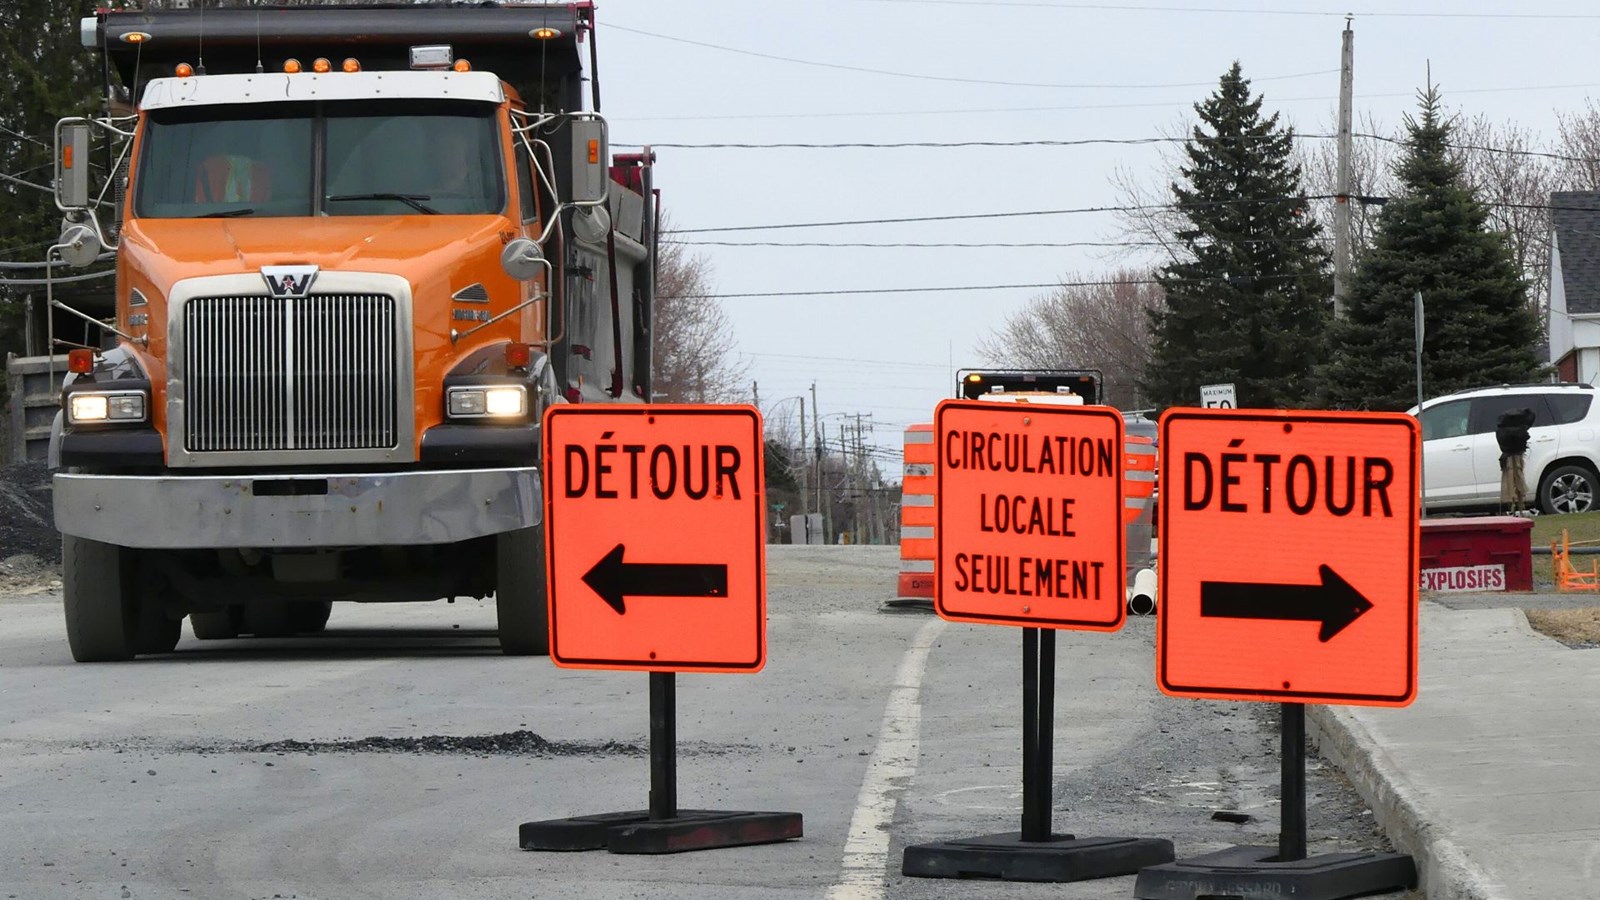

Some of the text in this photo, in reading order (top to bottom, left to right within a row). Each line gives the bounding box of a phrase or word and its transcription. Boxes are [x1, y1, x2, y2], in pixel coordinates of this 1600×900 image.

[564, 431, 741, 500] DÉTOUR
[946, 430, 1113, 477] CIRCULATION
[1184, 438, 1394, 518] DÉTOUR
[981, 494, 1076, 537] LOCALE
[955, 552, 1104, 600] SEULEMENT
